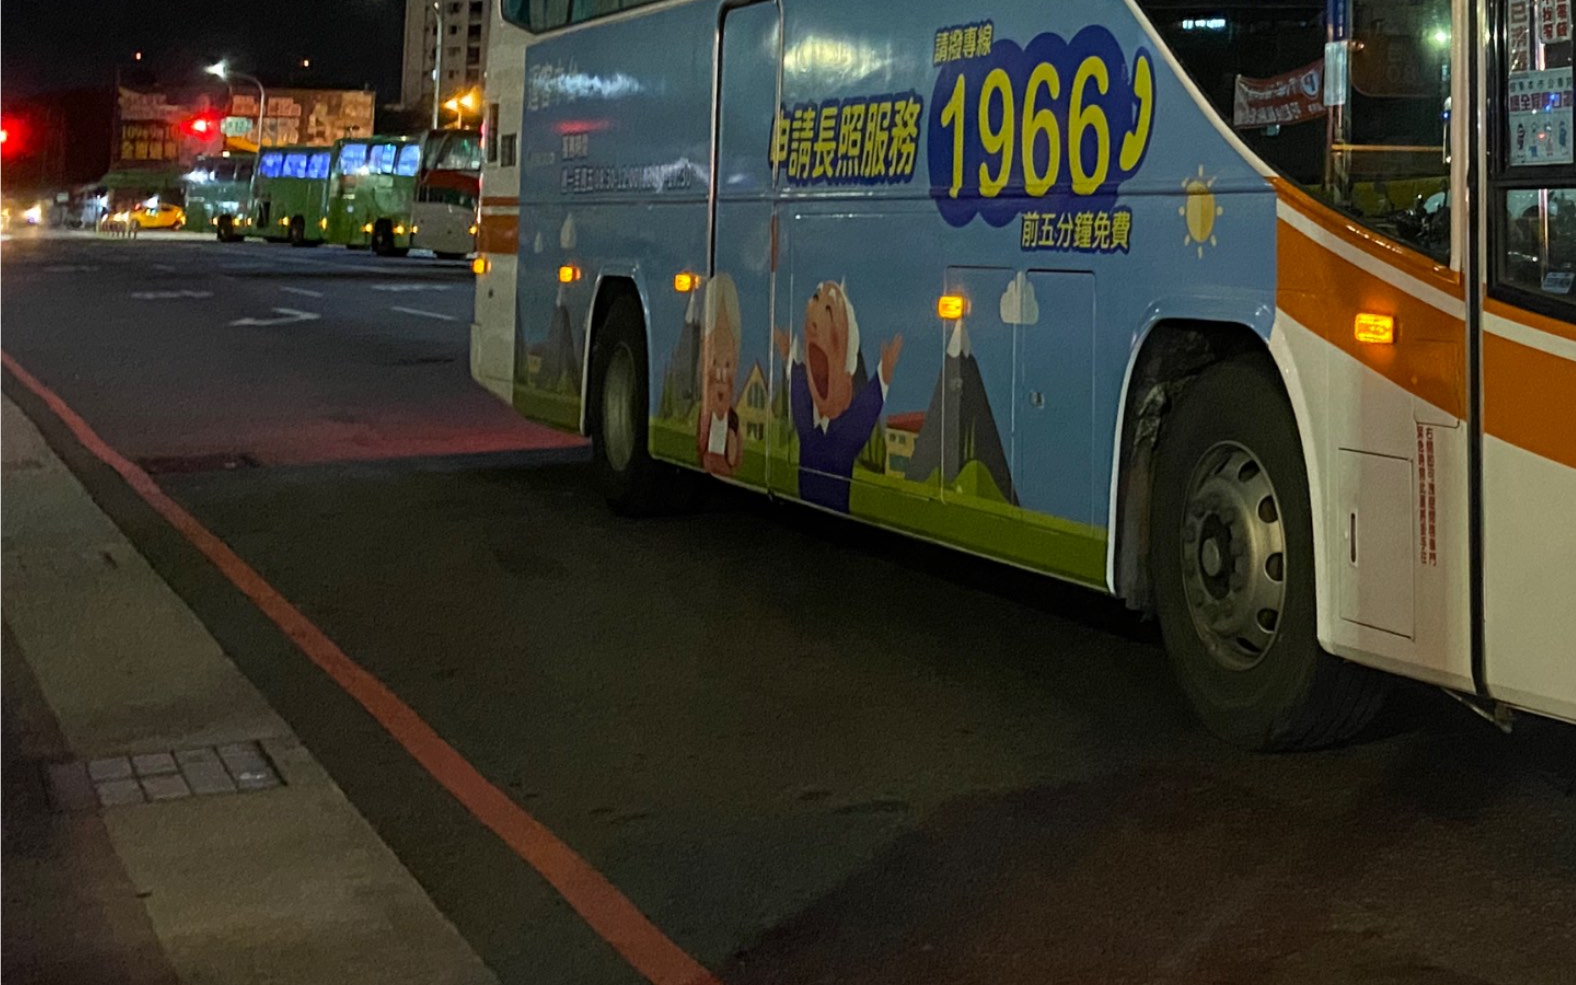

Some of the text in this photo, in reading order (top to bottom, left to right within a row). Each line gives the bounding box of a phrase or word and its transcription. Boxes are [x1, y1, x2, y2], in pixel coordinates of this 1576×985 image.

[933, 23, 993, 63] 請撥專線
[770, 97, 922, 179] 申請長照服務
[941, 55, 1110, 199] 1966
[1021, 210, 1132, 251] 前五分鐘免費
